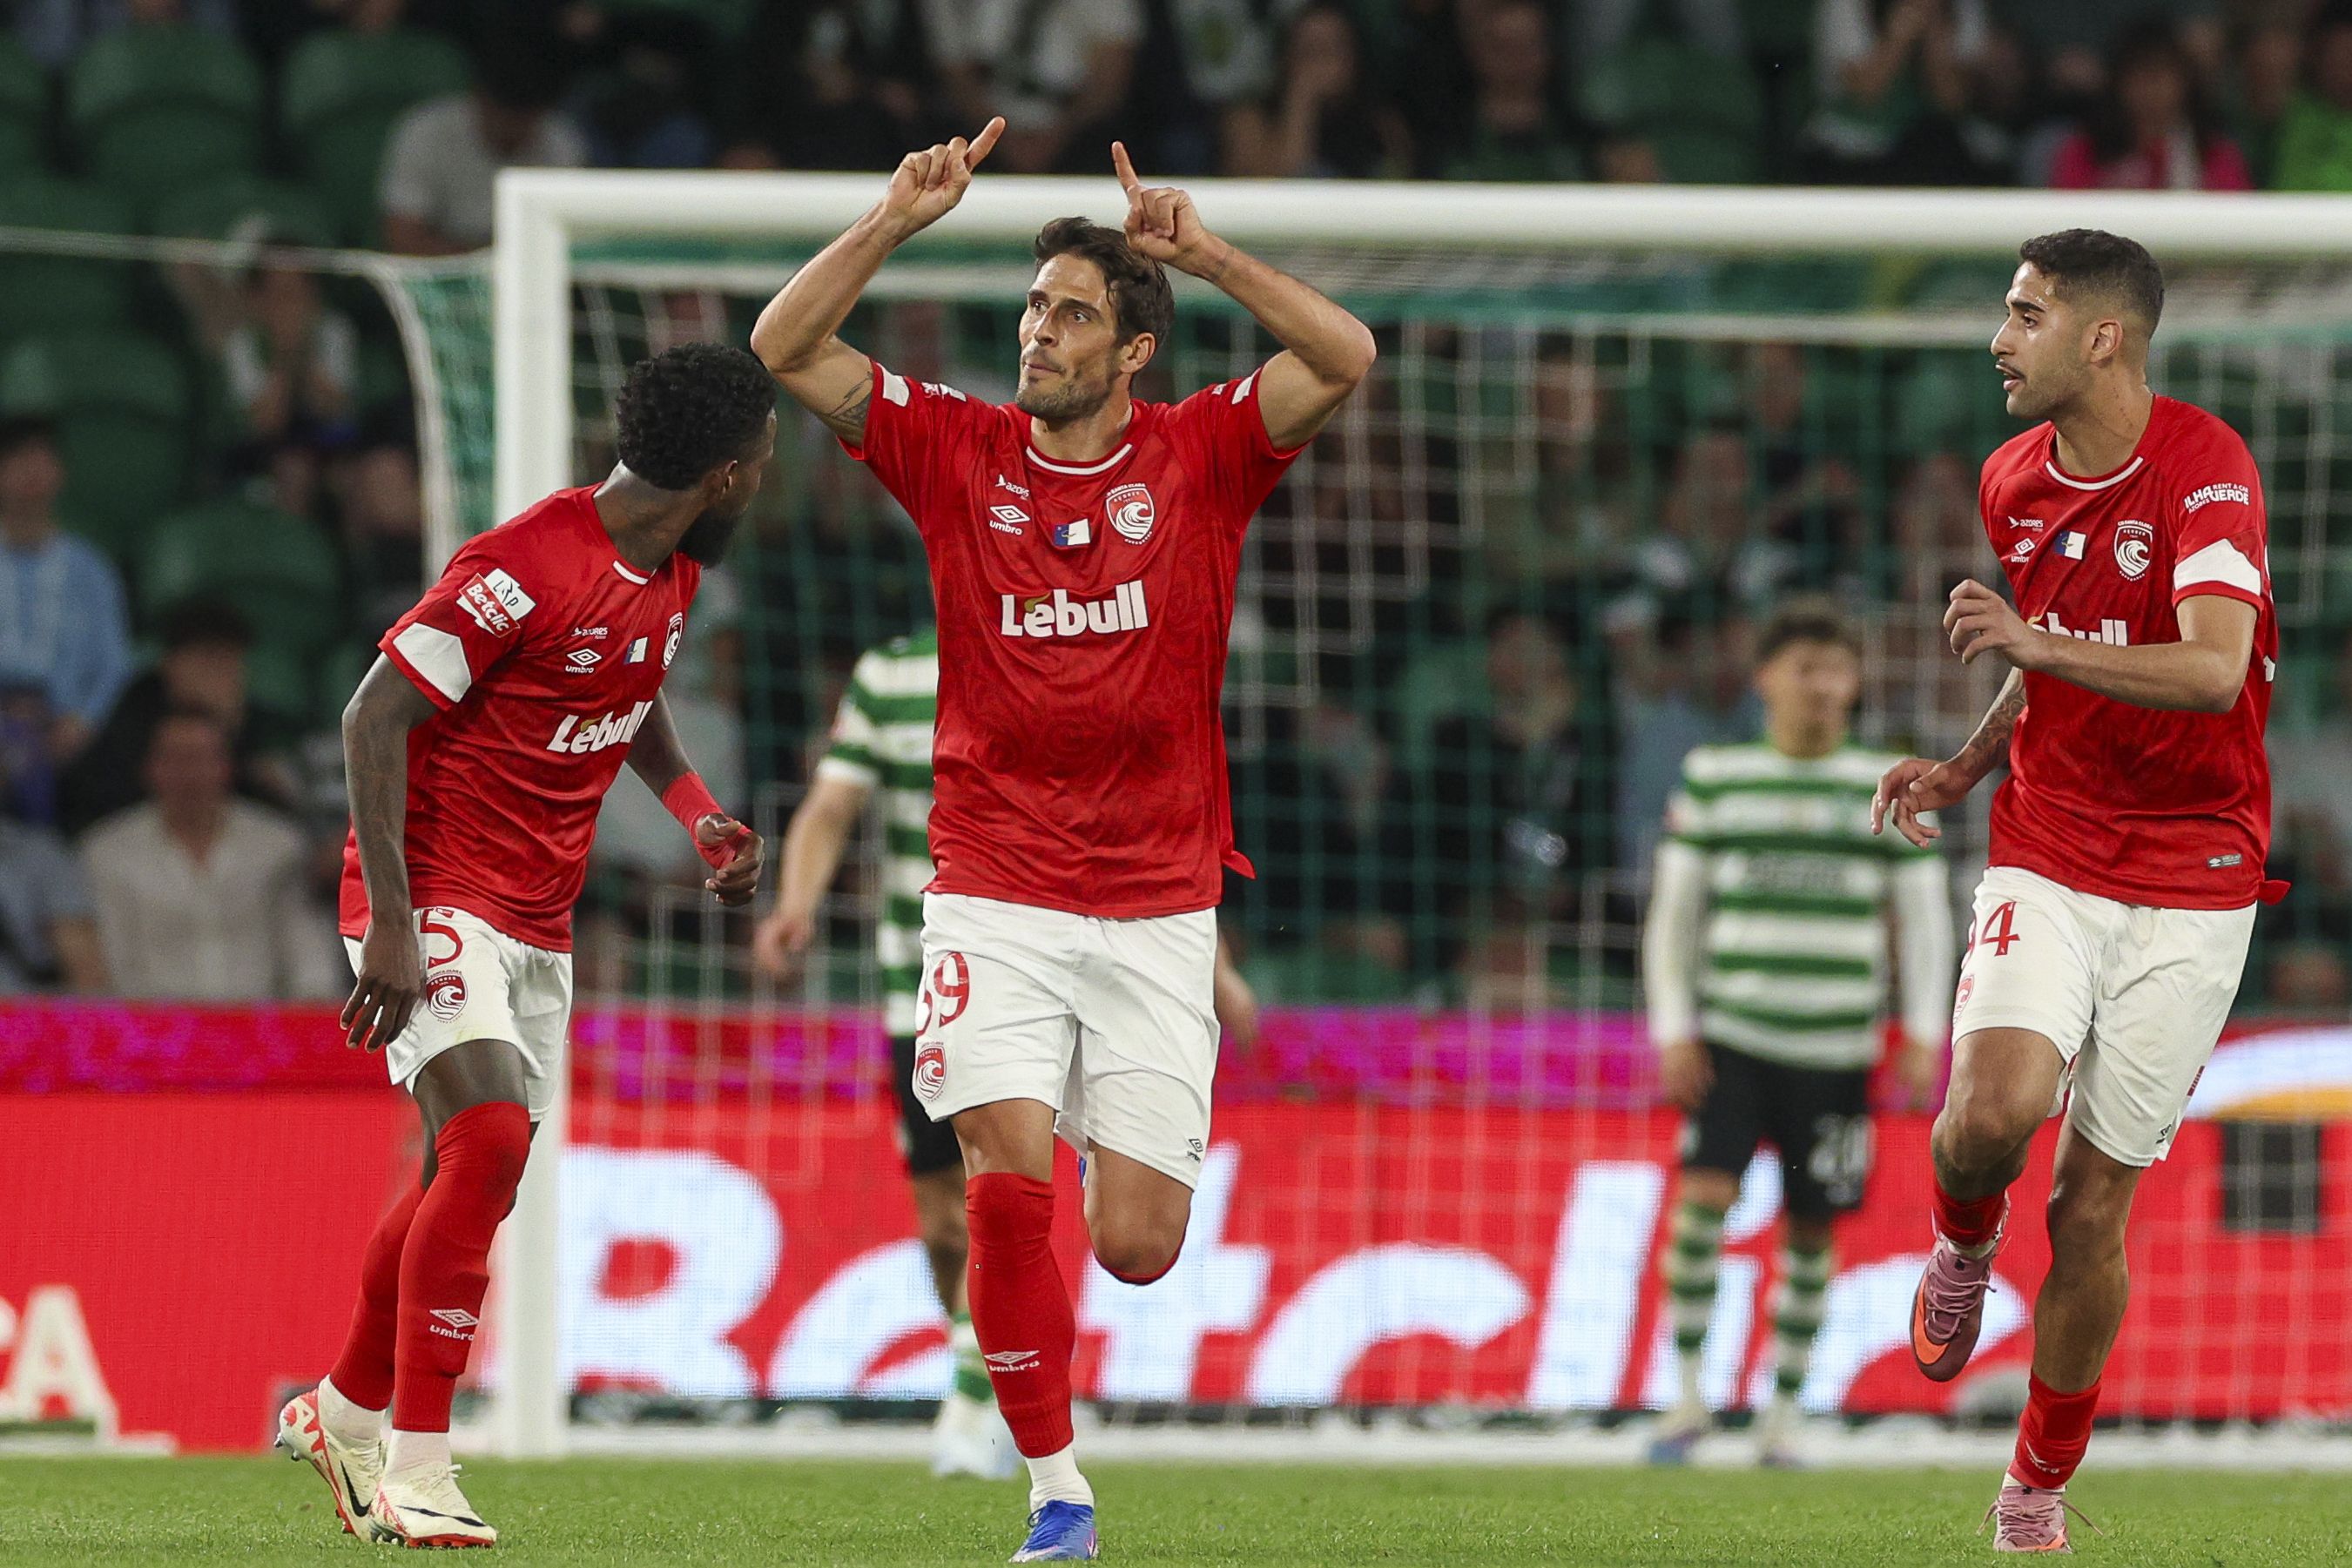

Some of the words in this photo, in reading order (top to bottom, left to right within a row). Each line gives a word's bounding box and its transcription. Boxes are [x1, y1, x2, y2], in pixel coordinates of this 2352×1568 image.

[2184, 486, 2212, 509] ILHA
[2209, 489, 2249, 505] VERDE
[989, 520, 1022, 535] umbro
[467, 582, 509, 631] Betclic
[1001, 580, 1149, 637] Lebull
[565, 664, 594, 674] umbro
[429, 1324, 475, 1341] umbro
[989, 1360, 1040, 1373] umbro
